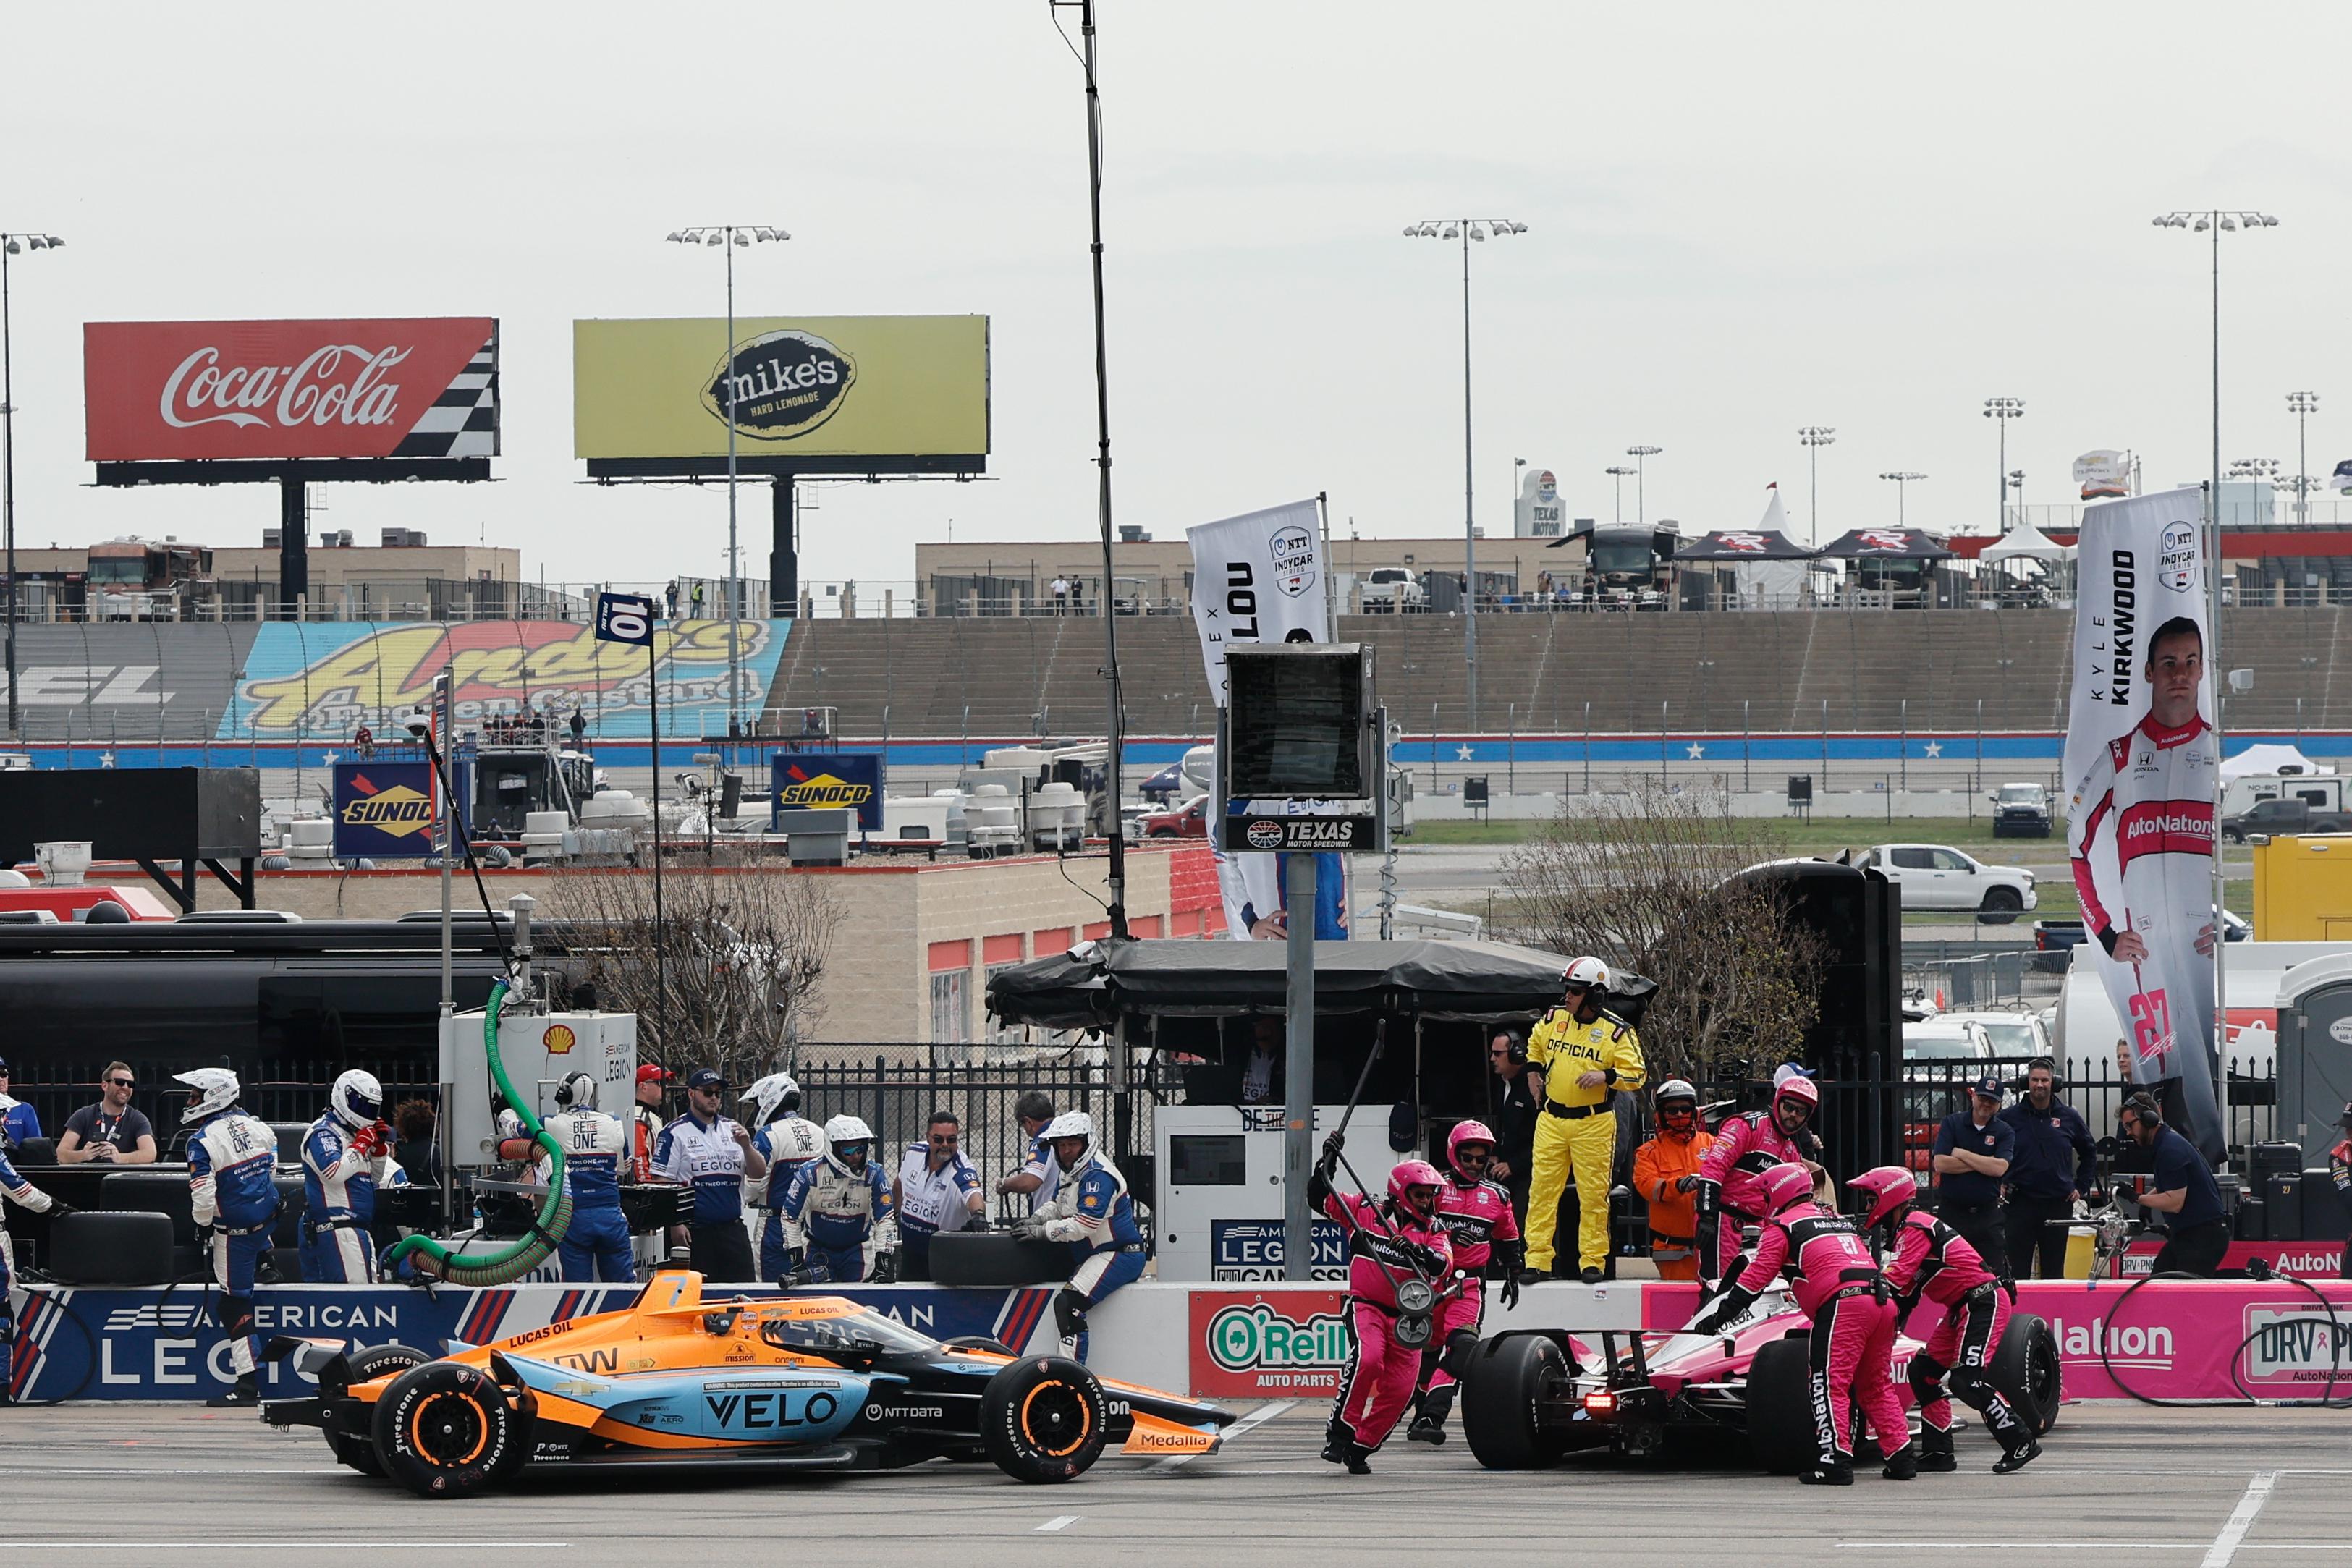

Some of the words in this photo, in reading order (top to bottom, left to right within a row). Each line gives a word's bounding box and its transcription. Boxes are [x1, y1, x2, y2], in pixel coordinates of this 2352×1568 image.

[161, 345, 414, 428] Coca-Cola
[723, 355, 839, 407] mike's
[750, 400, 774, 418] HARD
[777, 391, 820, 413] LEMONADE
[1534, 507, 1559, 521] TEXAS
[1532, 522, 1560, 536] MOTOR
[2177, 532, 2192, 544] NTT
[1287, 536, 1307, 550] NTT
[1274, 554, 1314, 572] INDYCAR
[2161, 551, 2195, 565] INDYCAR
[1227, 563, 1259, 643] LOU
[600, 601, 609, 631] PALOU
[609, 601, 649, 640] 10
[2111, 550, 2136, 706] KIRKWOOD
[2091, 616, 2105, 701] KYLE
[2161, 732, 2190, 744] AutoNation
[785, 785, 868, 802] SUNOCO
[347, 801, 432, 822] SUNOC
[1287, 821, 1353, 840] TEXAS
[2128, 814, 2212, 839] AutoNation
[2128, 988, 2172, 1056] 27
[614, 1044, 630, 1054] AMERICAN
[1547, 1038, 1603, 1062] OFFICIAL
[605, 1059, 630, 1082] LEGION
[573, 1121, 586, 1134] BE
[1243, 1109, 1263, 1132] BE
[1265, 1114, 1285, 1127] THE
[227, 1125, 239, 1139] BE
[573, 1134, 598, 1149] ONE
[792, 1126, 801, 1137] BE
[232, 1134, 253, 1153] ONE
[796, 1136, 813, 1152] ONE
[690, 1161, 741, 1172] LEGION
[1771, 1171, 1800, 1193] AutoNation
[1882, 1176, 1911, 1195] AutoNation
[2282, 1185, 2291, 1194] 27
[1259, 1227, 1341, 1237] AMCAN
[1837, 1235, 1858, 1255] 27
[2123, 1259, 2136, 1271] DRV
[2276, 1253, 2342, 1272] AutoN
[662, 1276, 687, 1307] 7
[192, 1305, 397, 1328] AERICAN
[509, 1326, 551, 1349] LUCAS
[553, 1321, 574, 1335] OIL
[1217, 1313, 1347, 1360] O'Reill
[2261, 1323, 2316, 1363] DRV
[363, 1355, 421, 1375] Fireston
[1256, 1374, 1291, 1387] AUTO
[1293, 1374, 1335, 1387] PARTS
[2293, 1371, 2352, 1381] AutoNaion
[706, 1391, 837, 1429] VELO
[885, 1407, 910, 1417] NTT
[1086, 1376, 1107, 1433] Firestone
[394, 1387, 418, 1454] Firestone
[1812, 1370, 1835, 1465] AutoNation
[483, 1406, 506, 1472] Firestone
[1006, 1402, 1026, 1458] Firestone
[1141, 1434, 1207, 1448] Medallia
